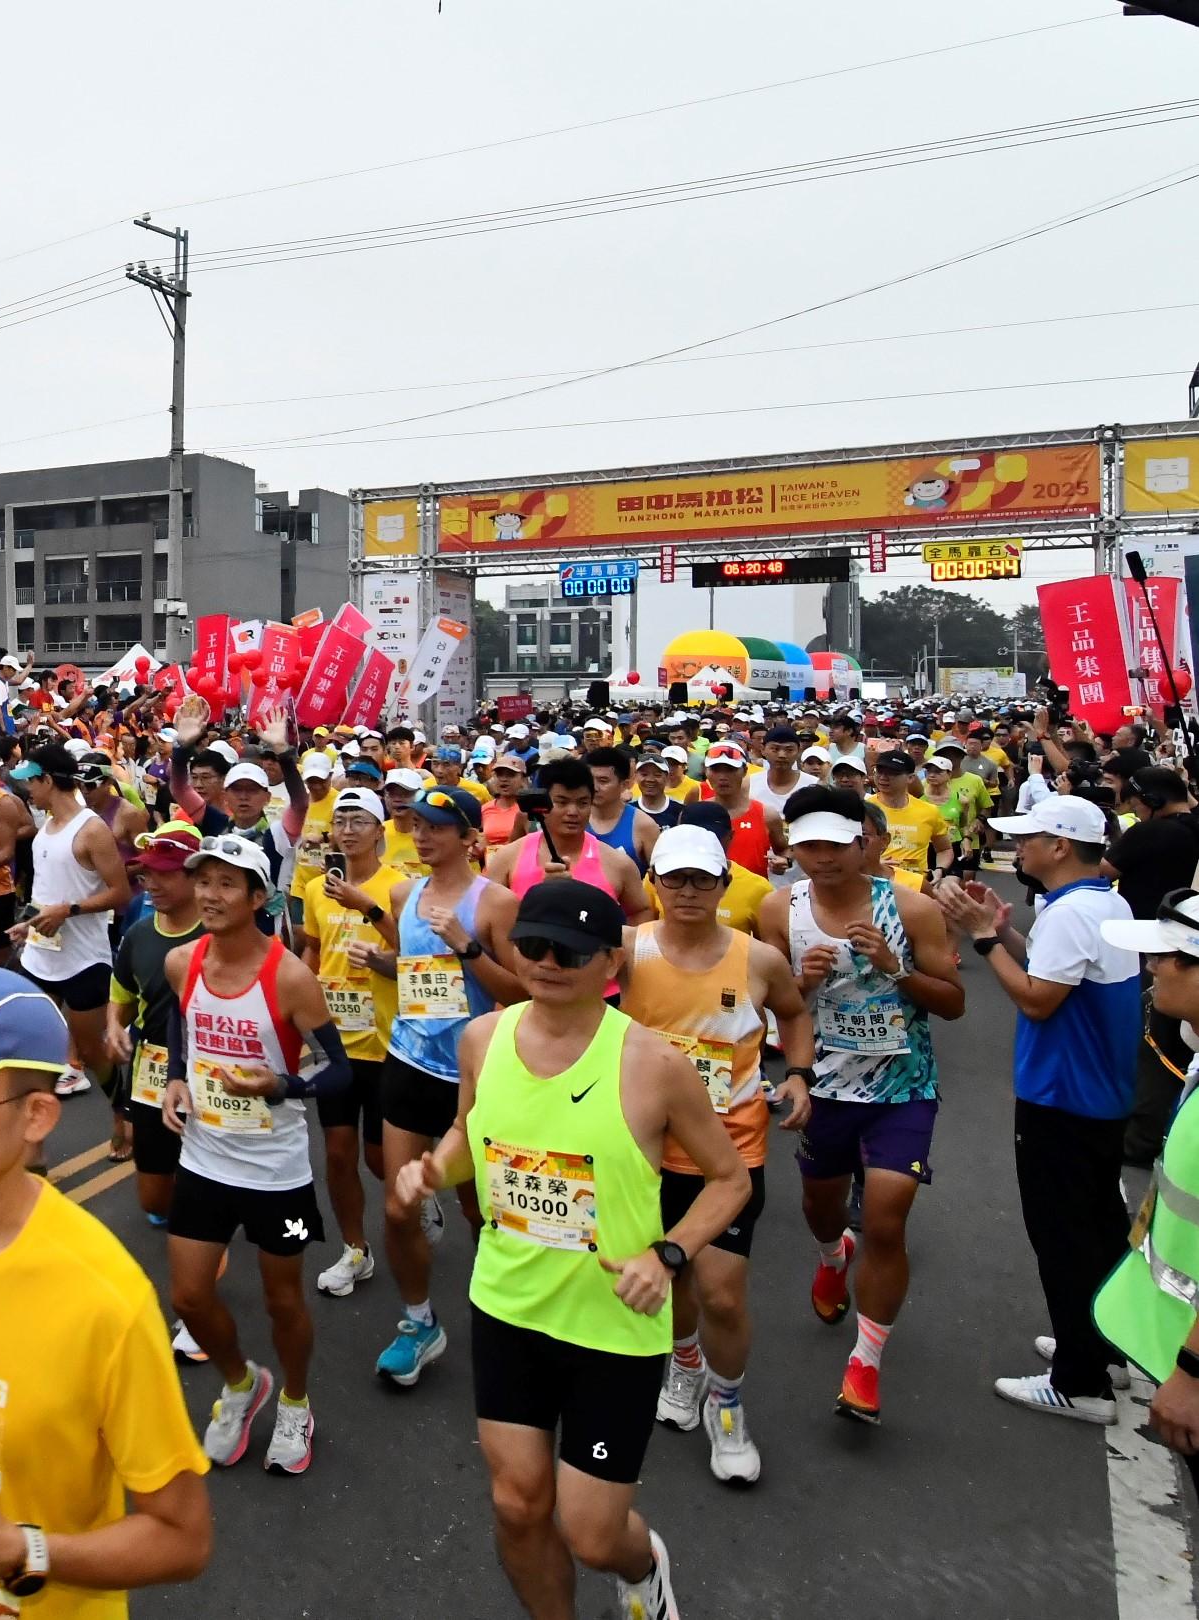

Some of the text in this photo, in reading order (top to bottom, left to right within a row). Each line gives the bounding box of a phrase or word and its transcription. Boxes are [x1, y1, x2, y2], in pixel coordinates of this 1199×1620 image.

[780, 481, 838, 492] TAIWAN'S
[1032, 481, 1089, 499] 2025
[617, 487, 764, 512] 田中馬拉松
[780, 488, 860, 502] RICE HEAVEN
[617, 506, 763, 522] TIANZHONG MARATHON
[933, 560, 1019, 580] 00:00:44
[1066, 602, 1105, 705] 王品集團
[412, 986, 449, 998] 11942
[329, 1003, 361, 1014] 12350
[195, 1012, 259, 1038] 阿公店
[837, 1024, 887, 1038] 25319
[207, 1095, 251, 1111] 10692
[507, 1191, 568, 1217] 10300
